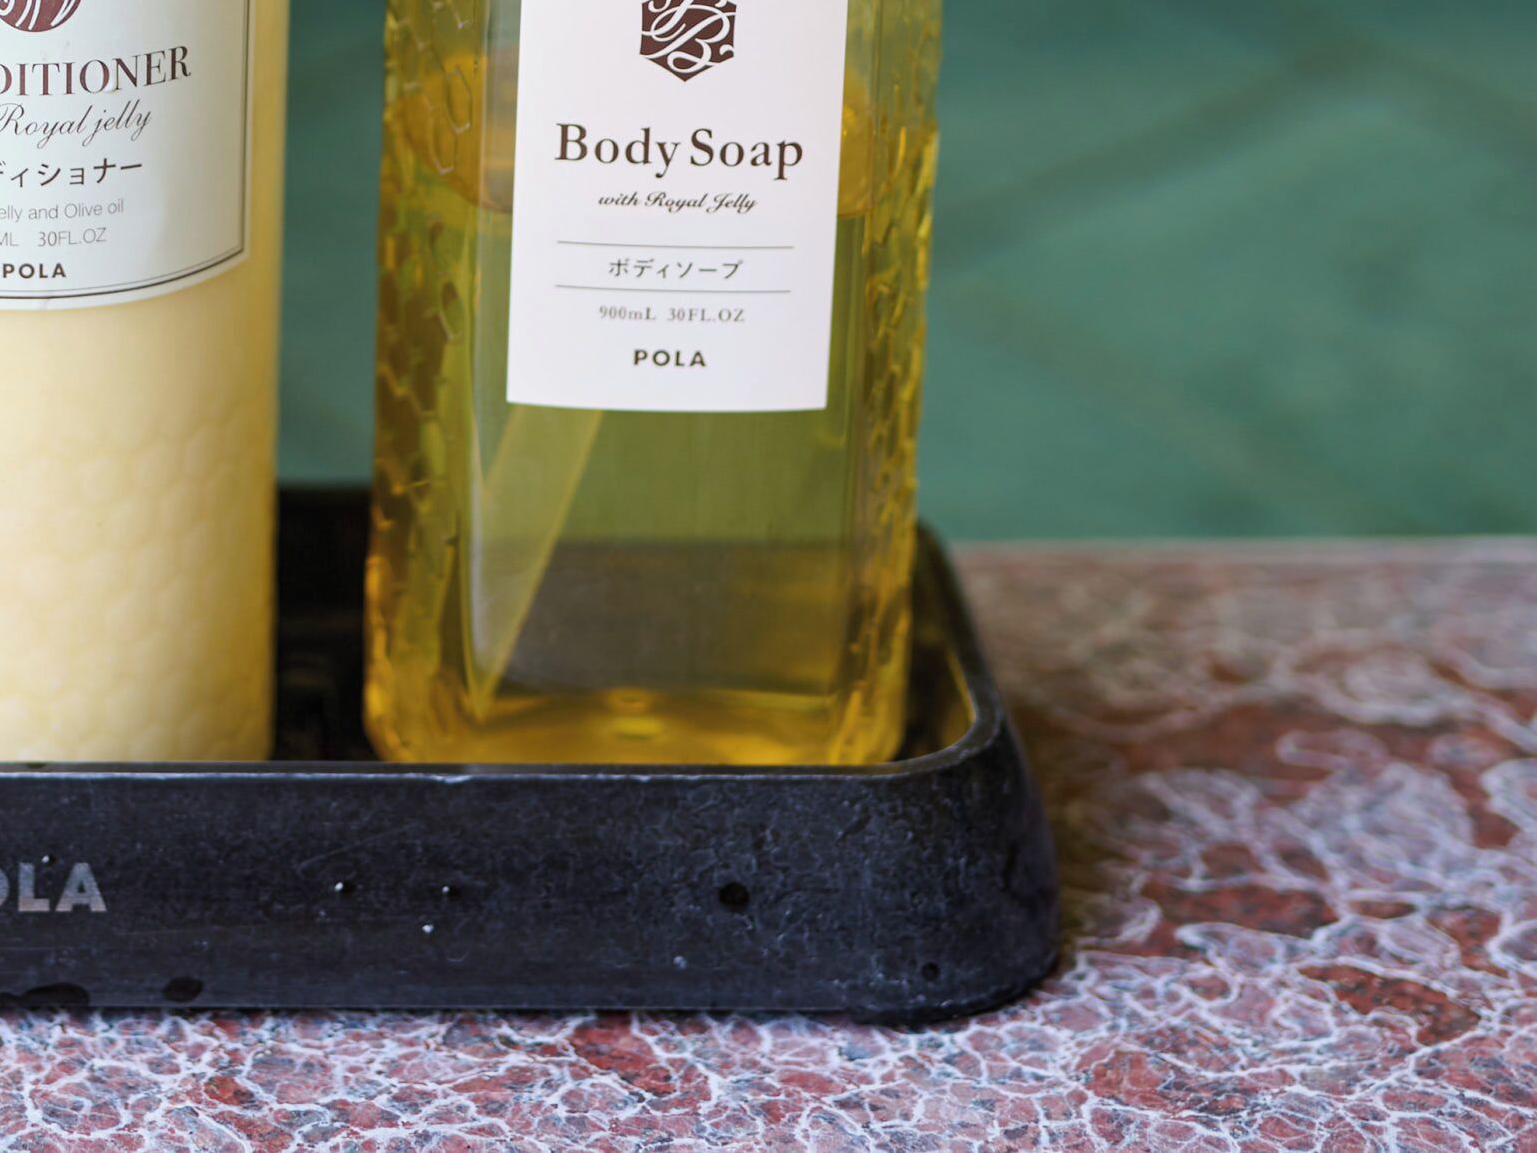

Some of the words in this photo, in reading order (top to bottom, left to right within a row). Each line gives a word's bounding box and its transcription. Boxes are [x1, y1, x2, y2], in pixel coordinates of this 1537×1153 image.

[82, 99, 153, 147] jelly
[555, 123, 681, 179] Body
[690, 128, 803, 181] Soap
[28, 204, 59, 219] and
[64, 201, 103, 219] Olive
[108, 199, 124, 215] oil
[598, 192, 640, 208] with
[644, 192, 708, 213] Royal
[708, 194, 758, 214] Jelly
[38, 227, 107, 247] 30FL.OZ
[3, 263, 66, 279] POLA
[609, 257, 744, 280] ボディソープ
[599, 305, 656, 321] 900mL
[667, 307, 745, 323] 30FL.OZ
[633, 349, 707, 367] POLA
